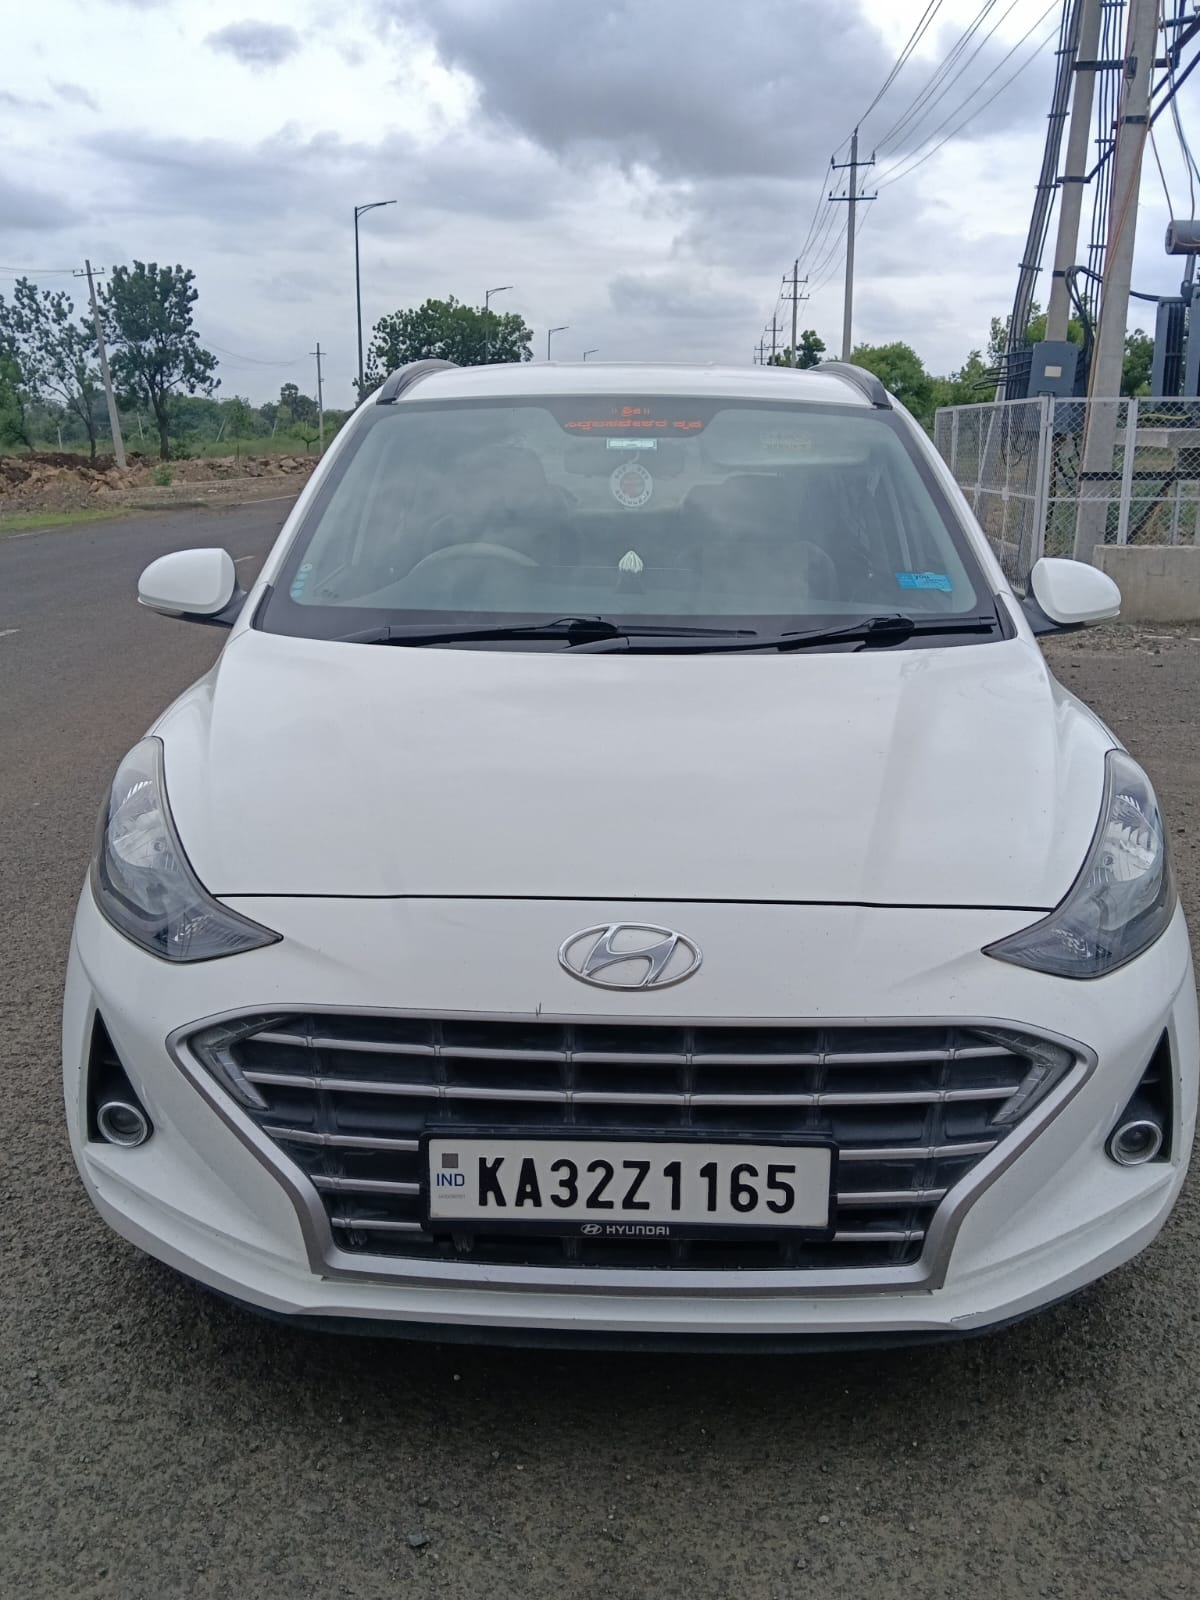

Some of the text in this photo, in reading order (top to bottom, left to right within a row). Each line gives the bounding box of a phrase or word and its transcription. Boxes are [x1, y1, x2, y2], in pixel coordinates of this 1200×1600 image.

[436, 1172, 465, 1187] IND
[479, 1157, 796, 1213] KA32Z1165
[606, 1225, 669, 1236] HYUNDAI
